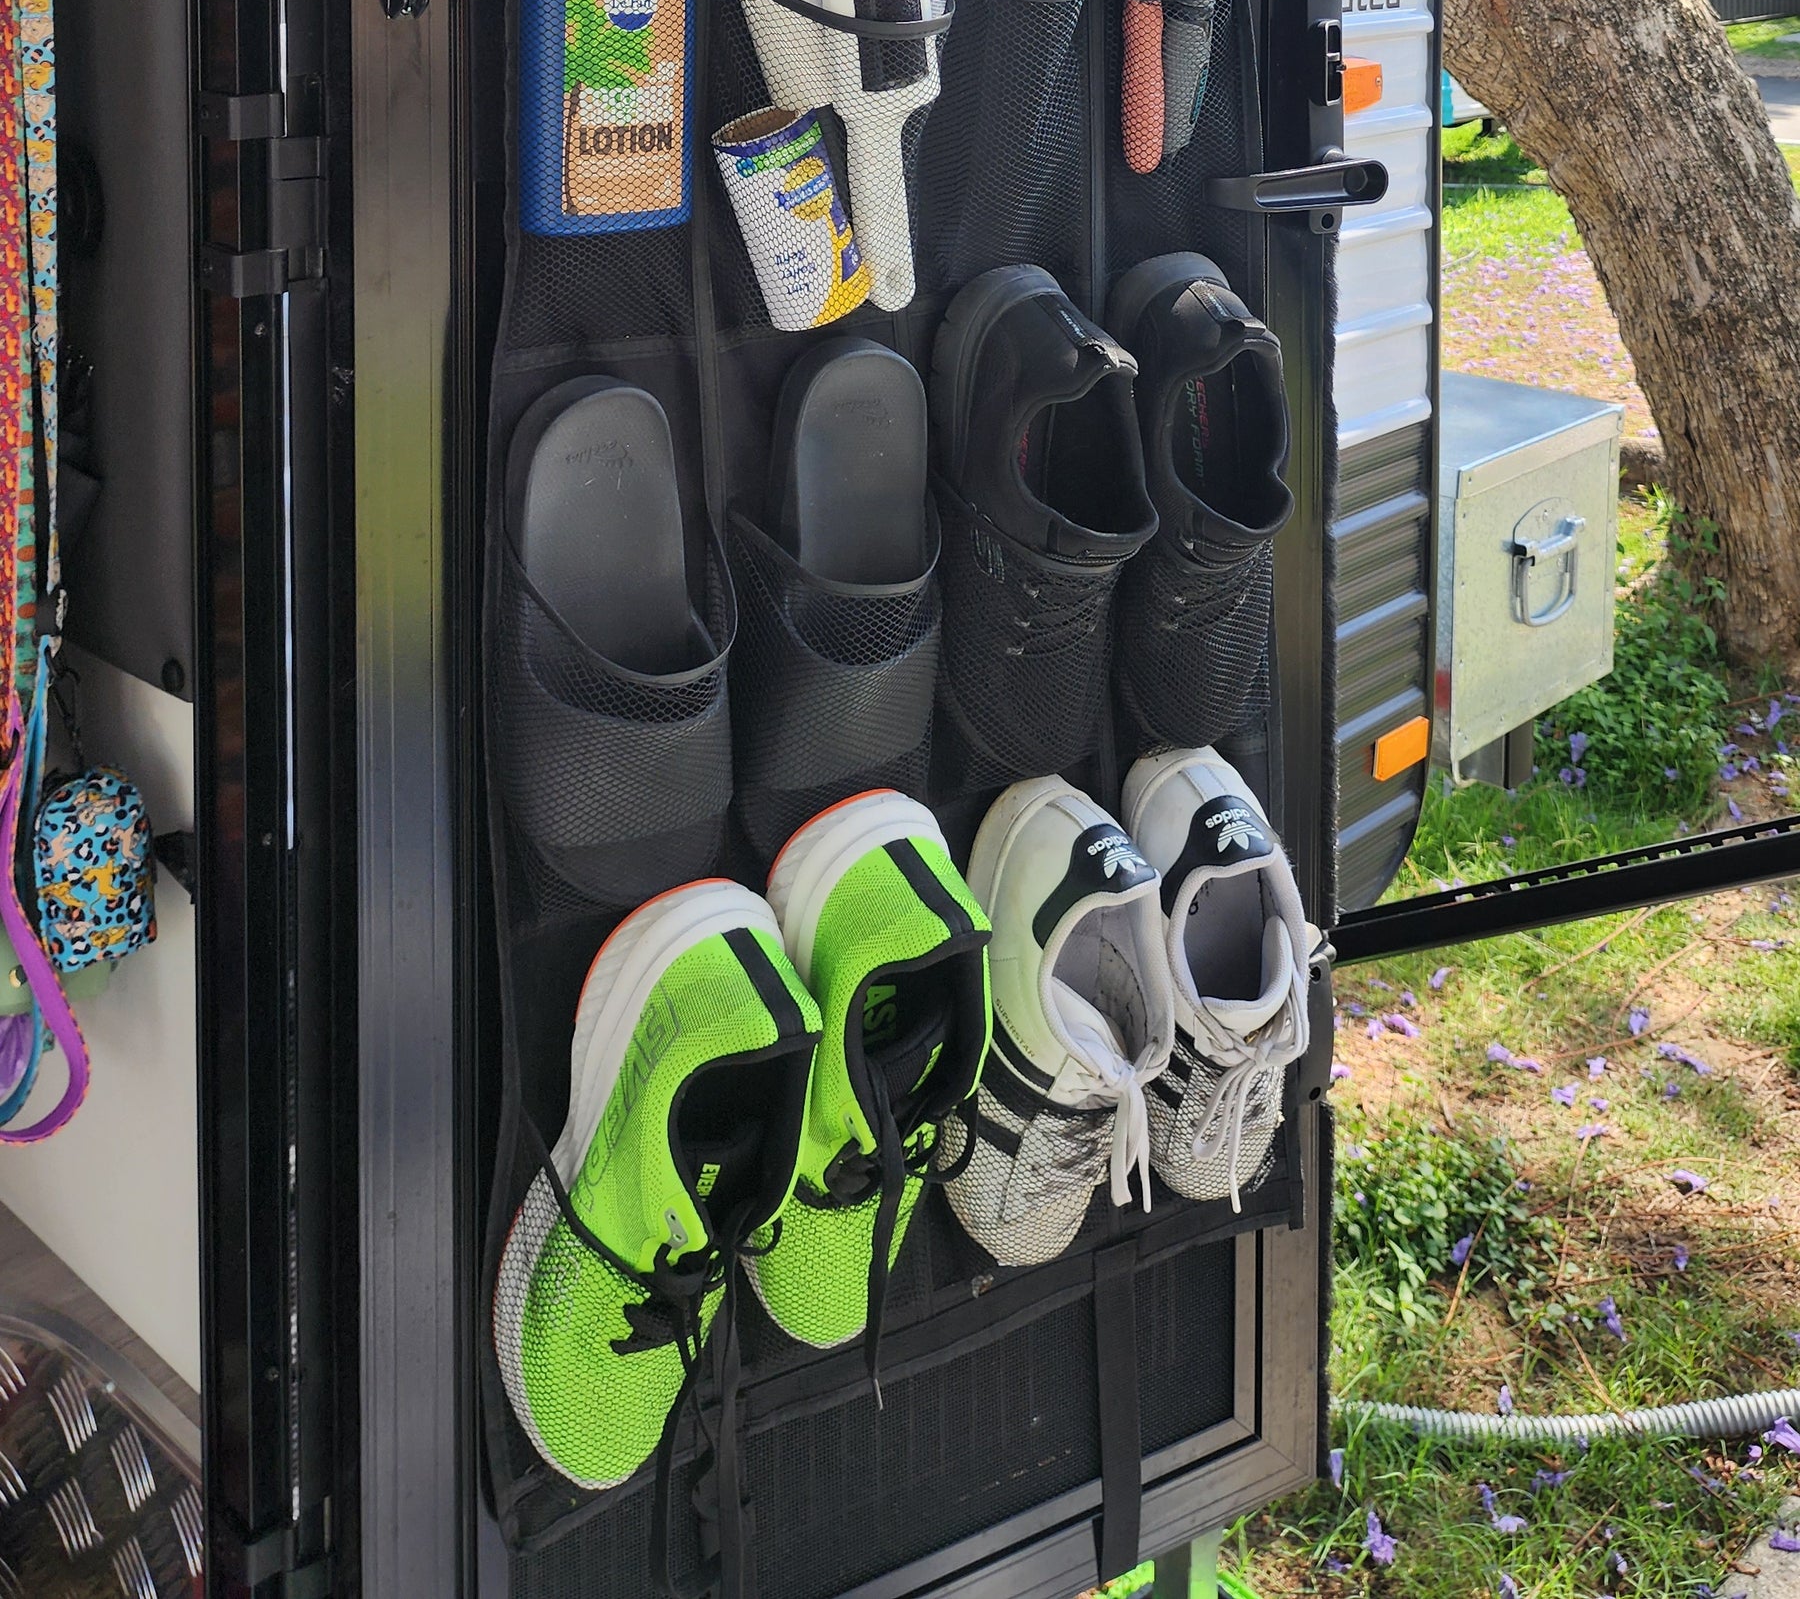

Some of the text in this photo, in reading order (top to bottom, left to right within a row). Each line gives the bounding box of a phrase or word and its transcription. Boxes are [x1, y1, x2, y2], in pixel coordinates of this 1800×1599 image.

[579, 122, 673, 155] LOTION
[1205, 808, 1251, 829] adidas
[1087, 835, 1129, 856] adidas
[996, 997, 1036, 1058] SUPERSTAR
